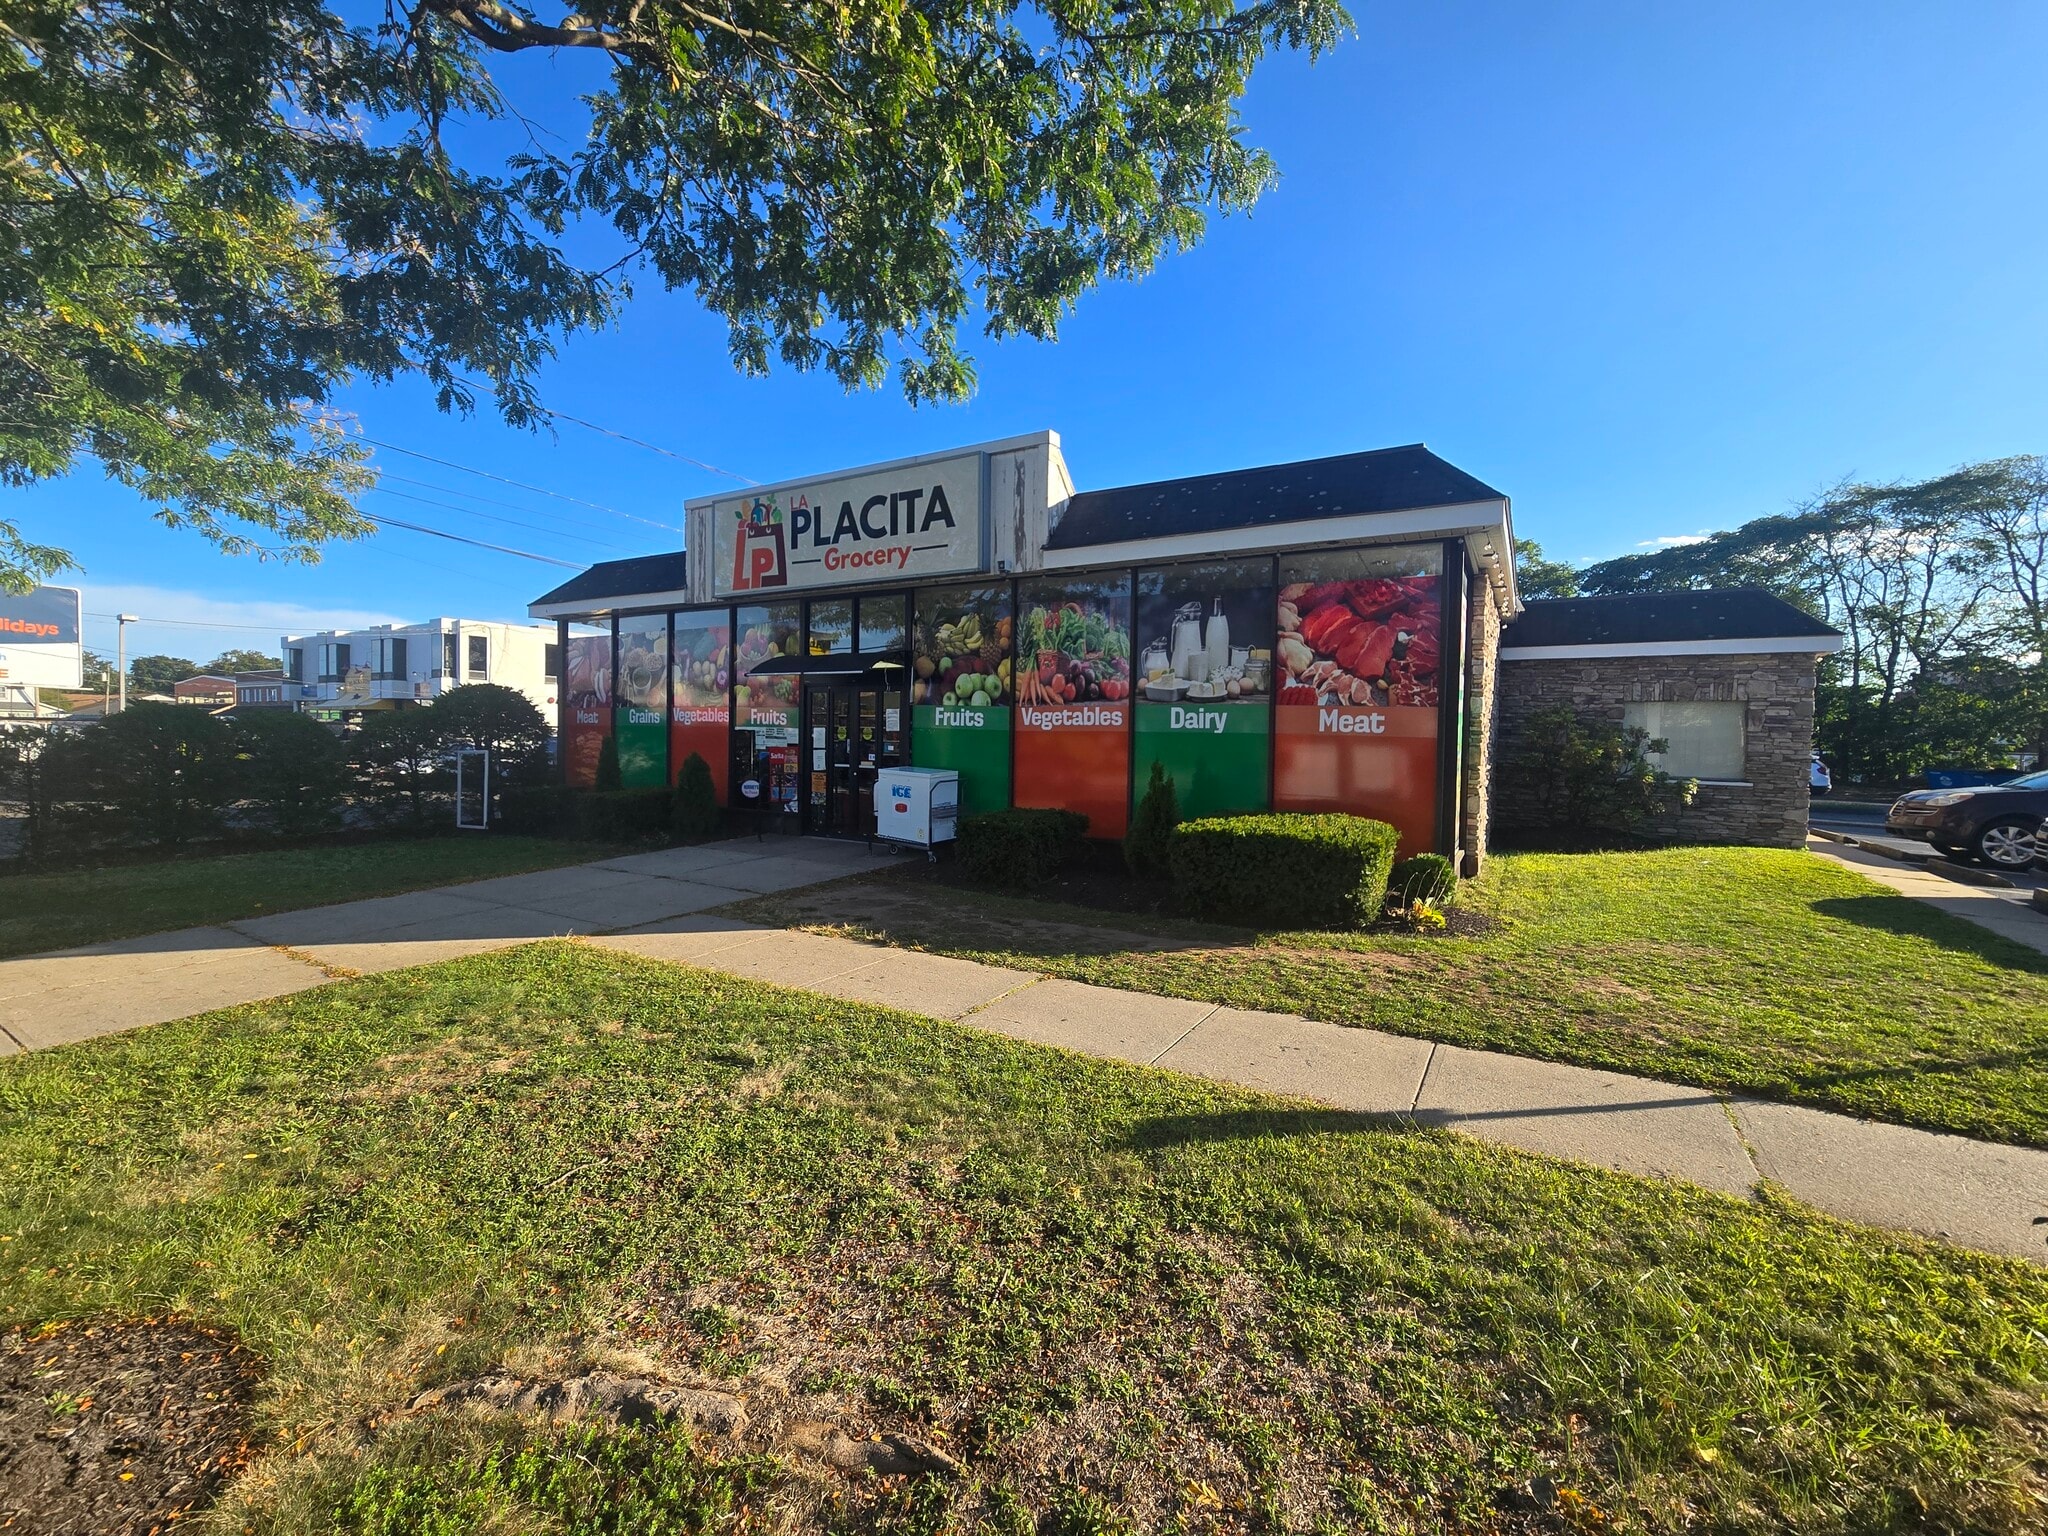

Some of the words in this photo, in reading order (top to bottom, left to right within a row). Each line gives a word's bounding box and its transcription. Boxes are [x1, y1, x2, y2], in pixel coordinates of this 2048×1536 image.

[790, 494, 808, 509] LA
[790, 484, 956, 550] PLACITA
[824, 546, 912, 571] Grocery
[576, 710, 599, 724] Meat
[629, 709, 660, 724] Grains
[673, 708, 729, 725] Vegetables
[750, 708, 787, 725] Fruits
[935, 707, 984, 727] Fruits
[1021, 707, 1123, 731] Vegetables
[1170, 707, 1228, 734] Dairy
[1318, 709, 1386, 733] Meat
[891, 783, 912, 799] ICE
